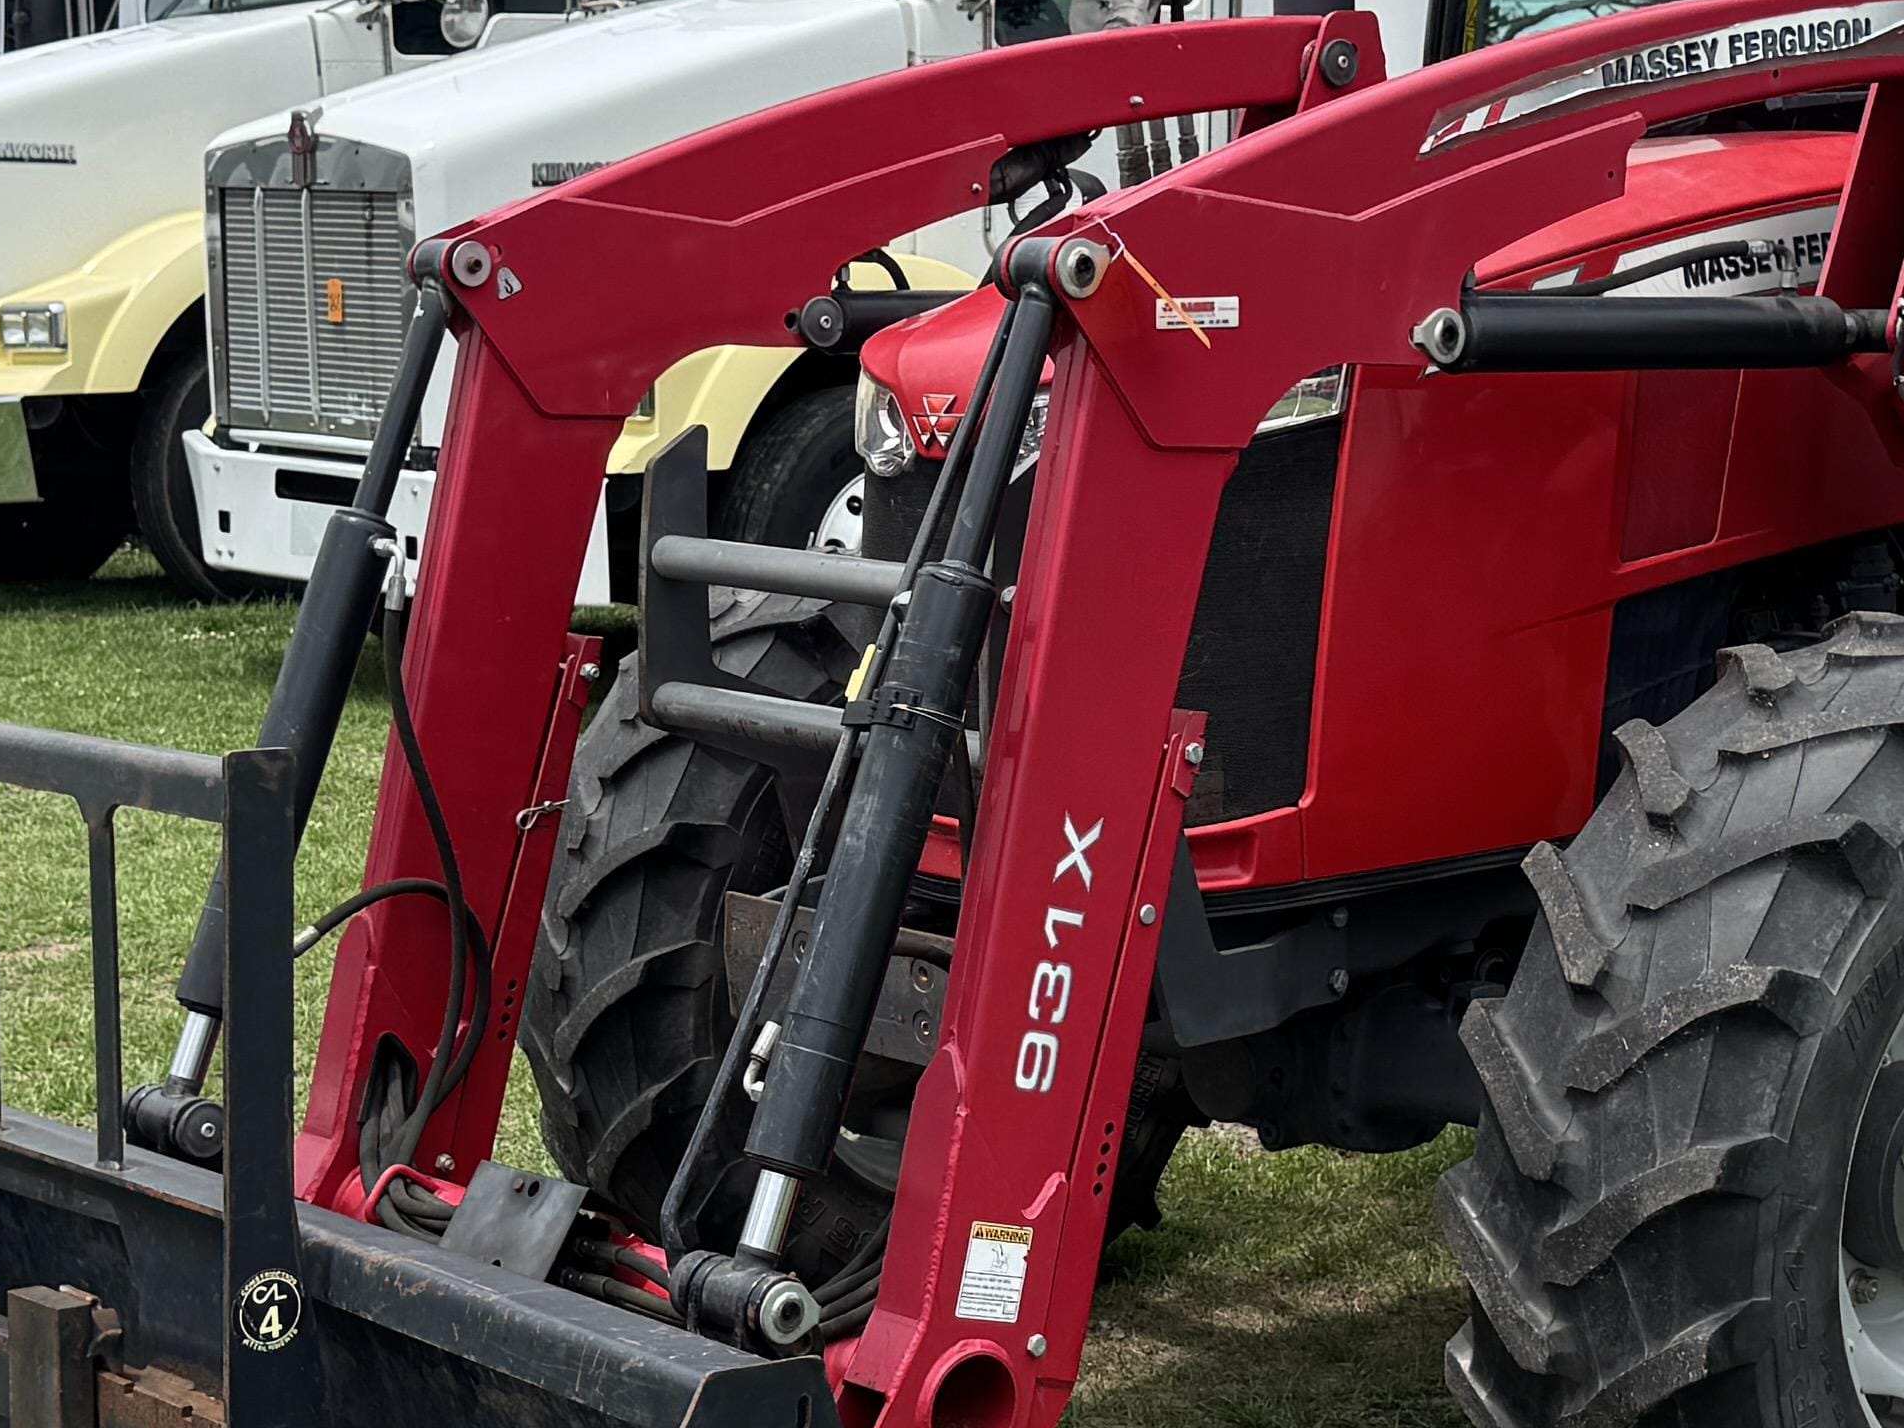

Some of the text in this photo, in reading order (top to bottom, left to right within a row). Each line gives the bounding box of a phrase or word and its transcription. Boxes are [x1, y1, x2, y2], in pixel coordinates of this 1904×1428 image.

[1601, 18, 1872, 87] MASSEY FERGUSON
[532, 162, 612, 183] KENW
[1015, 809, 1105, 1092] 931 X
[985, 1227, 1029, 1243] WARNING
[259, 1305, 283, 1339] 4
[1784, 1250, 1809, 1351] 24
